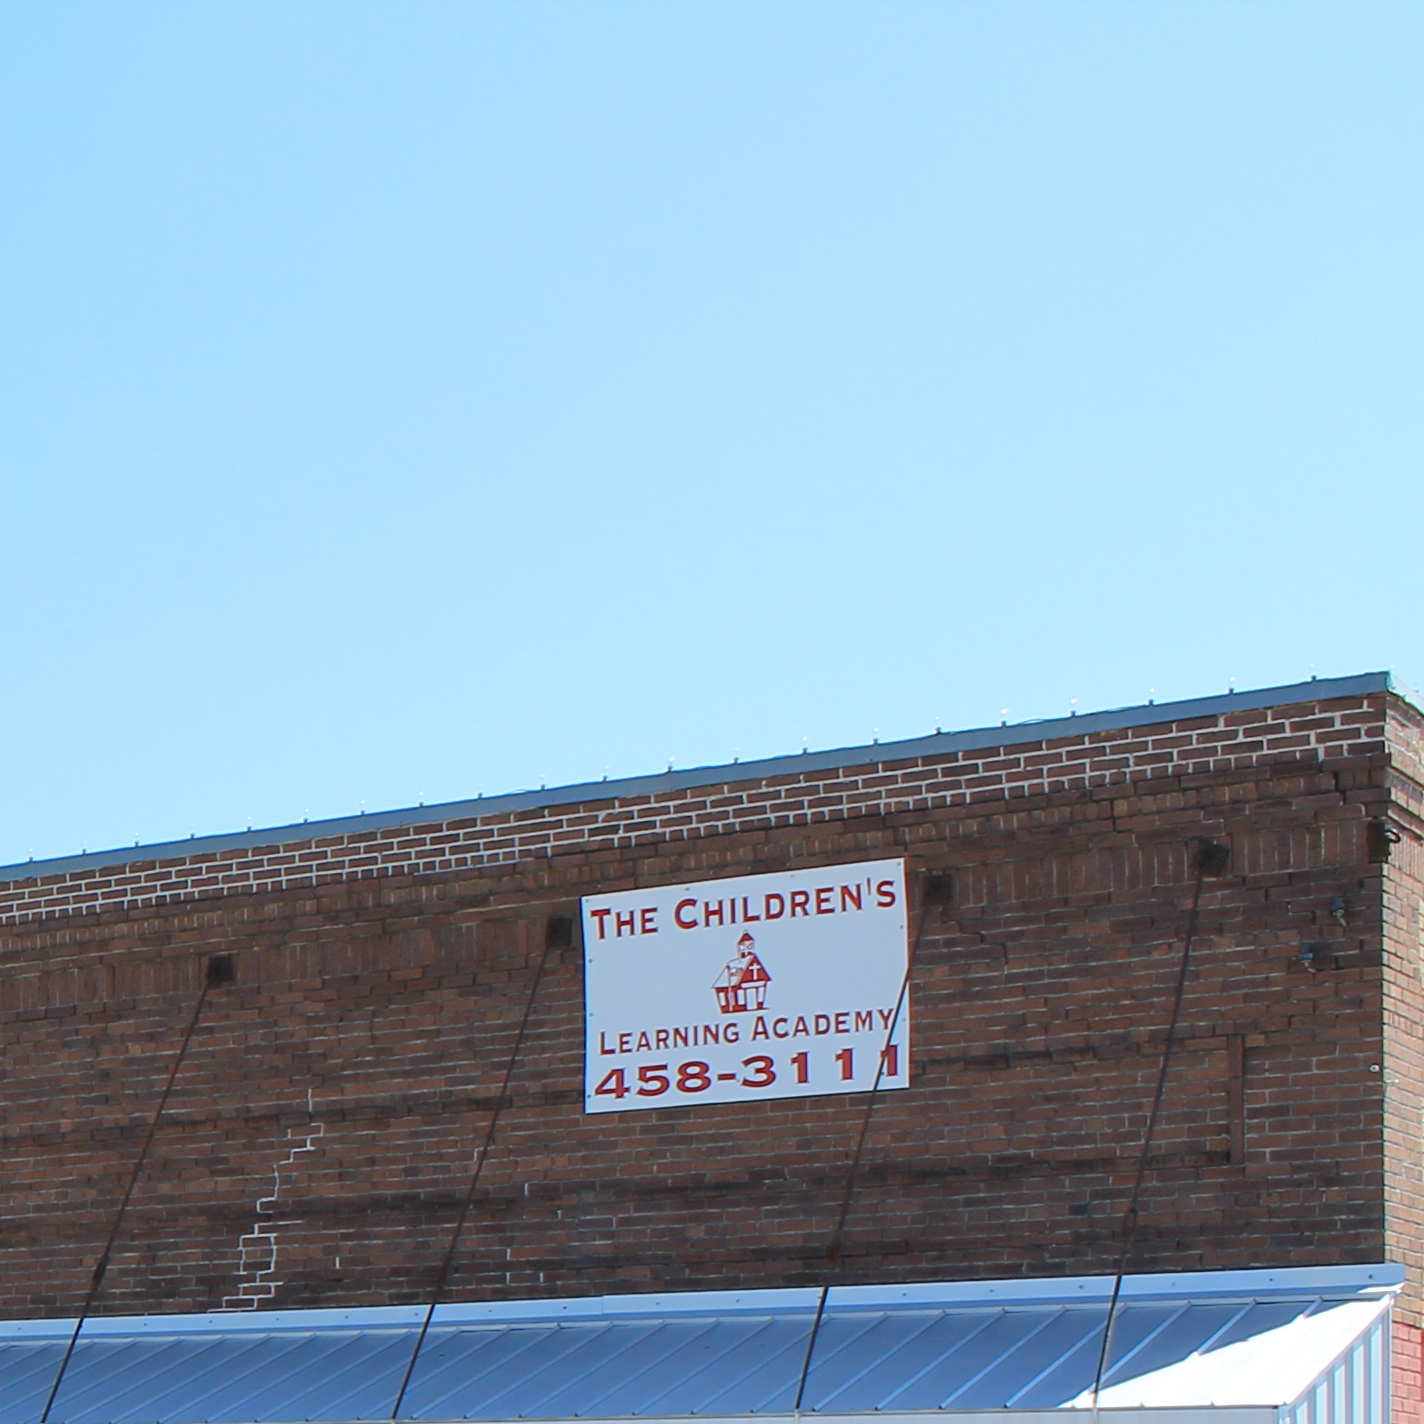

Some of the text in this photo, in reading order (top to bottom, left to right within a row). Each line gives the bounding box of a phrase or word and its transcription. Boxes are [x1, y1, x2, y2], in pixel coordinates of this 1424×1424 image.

[590, 877, 896, 940] THE CHILDREN'S
[600, 1007, 895, 1056] LEARNING ACADEMY
[594, 1044, 900, 1100] 458-3111
